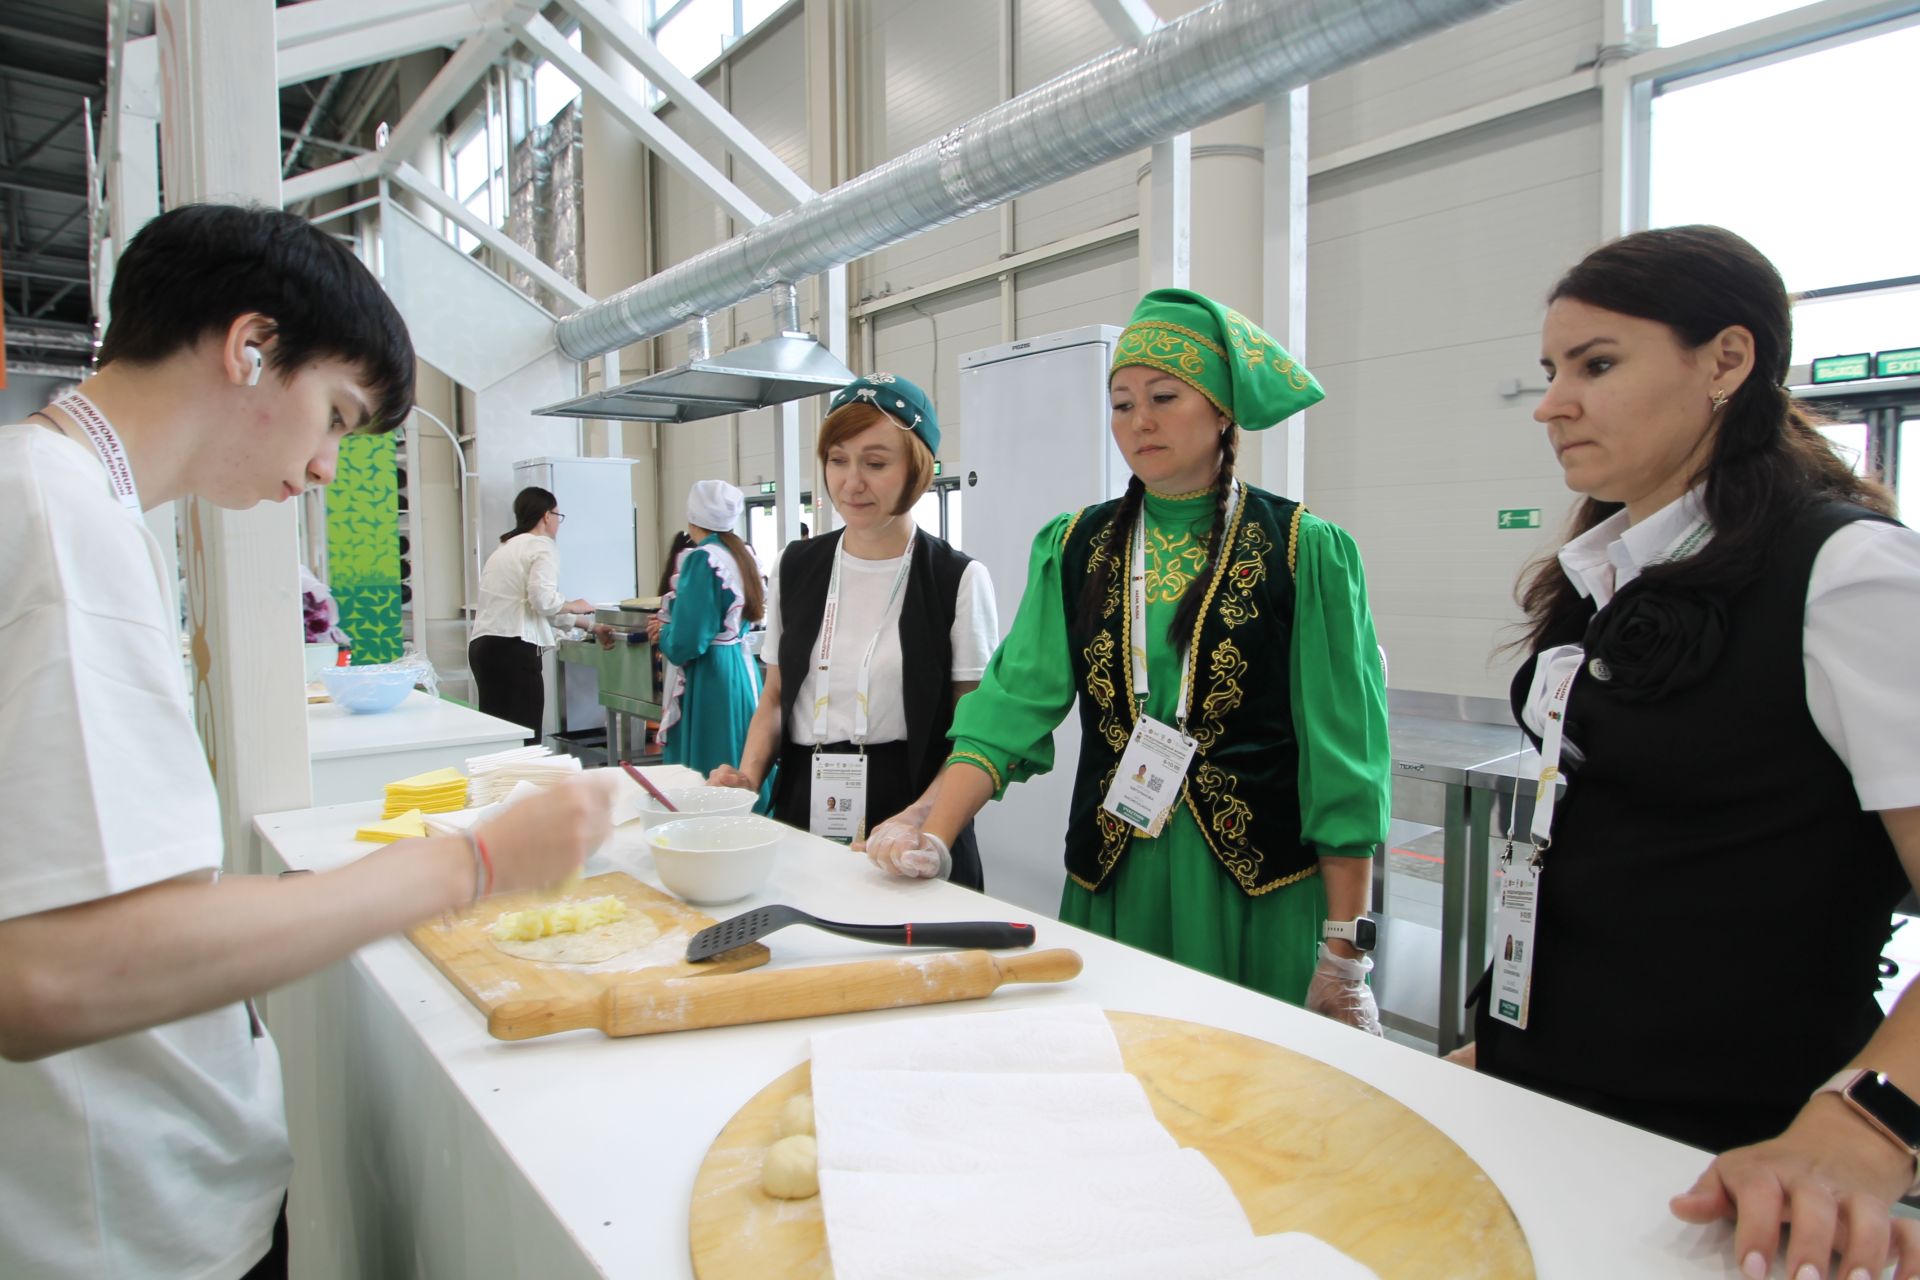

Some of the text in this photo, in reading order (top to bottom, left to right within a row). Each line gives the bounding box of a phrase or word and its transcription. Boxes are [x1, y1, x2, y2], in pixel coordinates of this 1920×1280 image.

[64, 403, 98, 436] CONSUMER
[94, 436, 125, 496] COOPERATION
[69, 394, 133, 496] INTERNATIONAL FORUM
